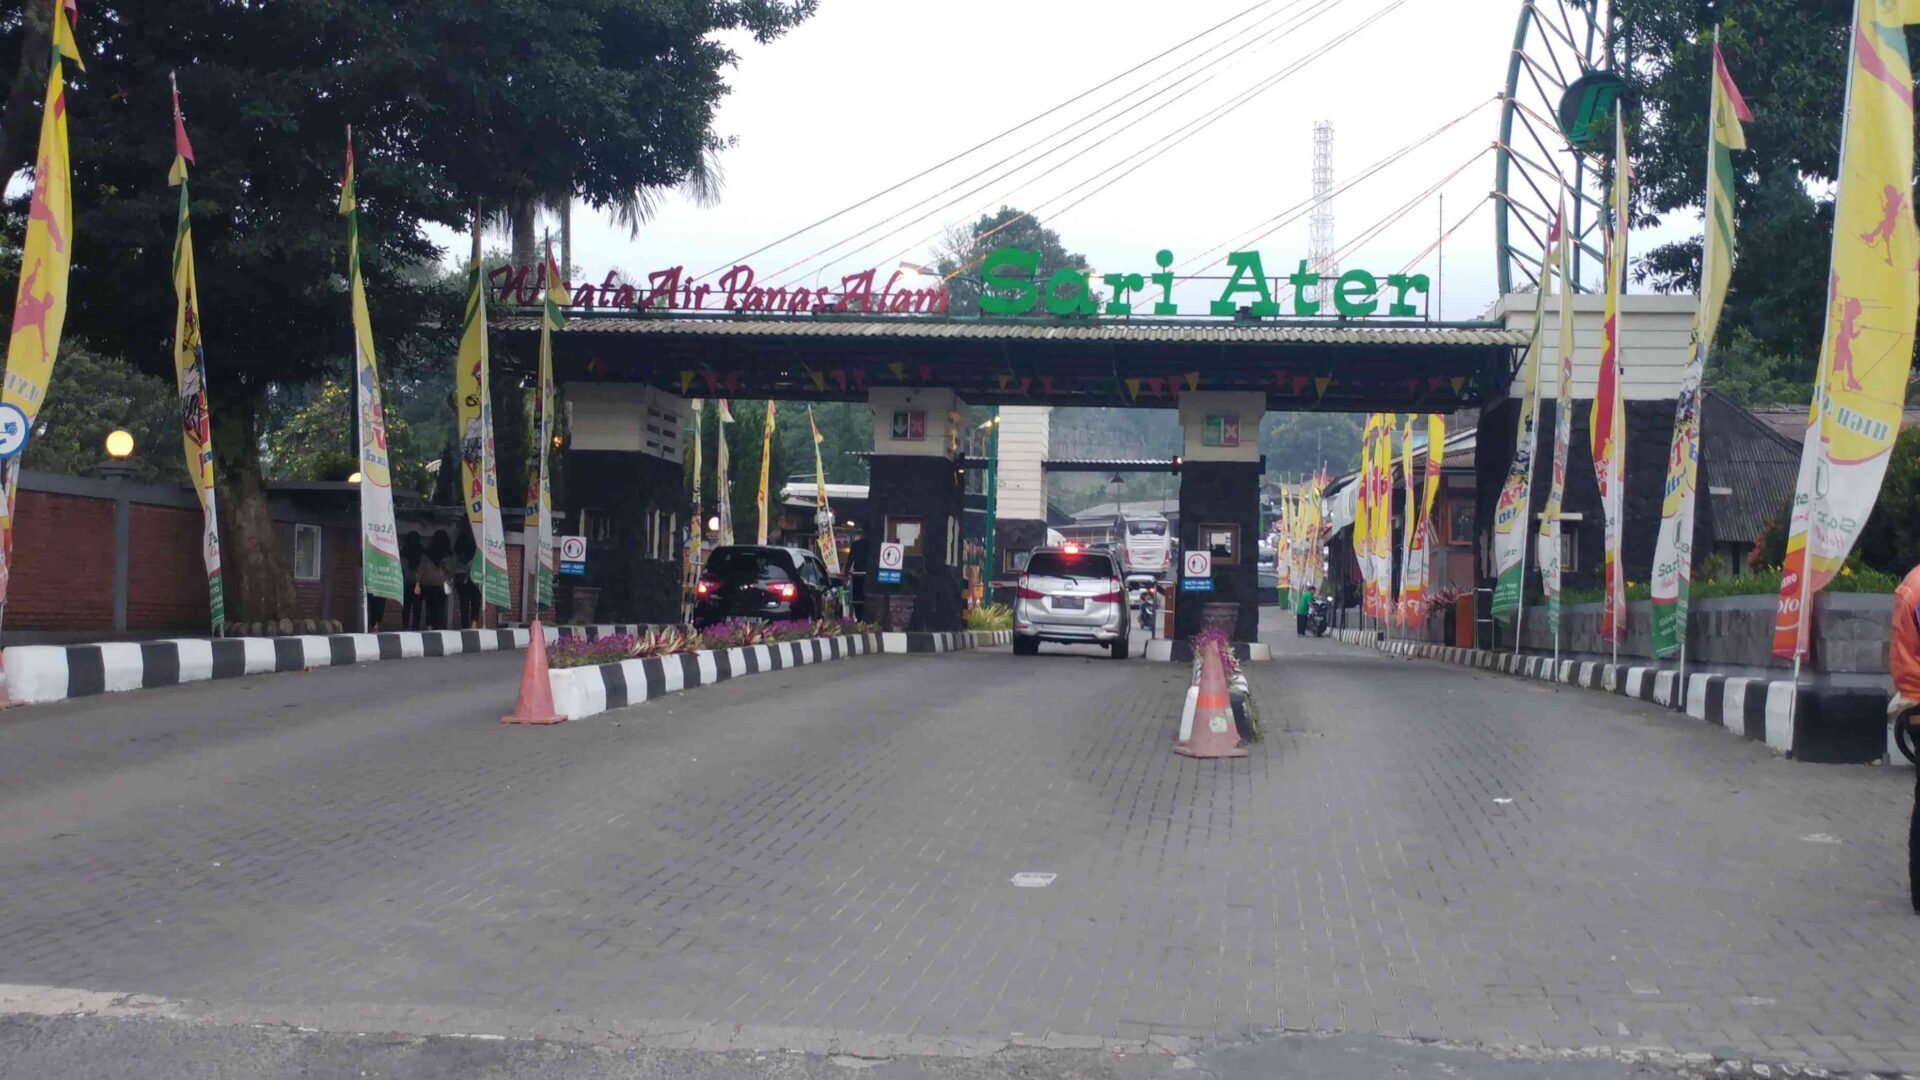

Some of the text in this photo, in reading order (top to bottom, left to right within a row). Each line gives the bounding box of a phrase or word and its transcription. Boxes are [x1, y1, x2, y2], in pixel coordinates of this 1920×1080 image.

[487, 263, 949, 314] Wata Air Panas Alam
[981, 249, 1430, 316] Sari Ater
